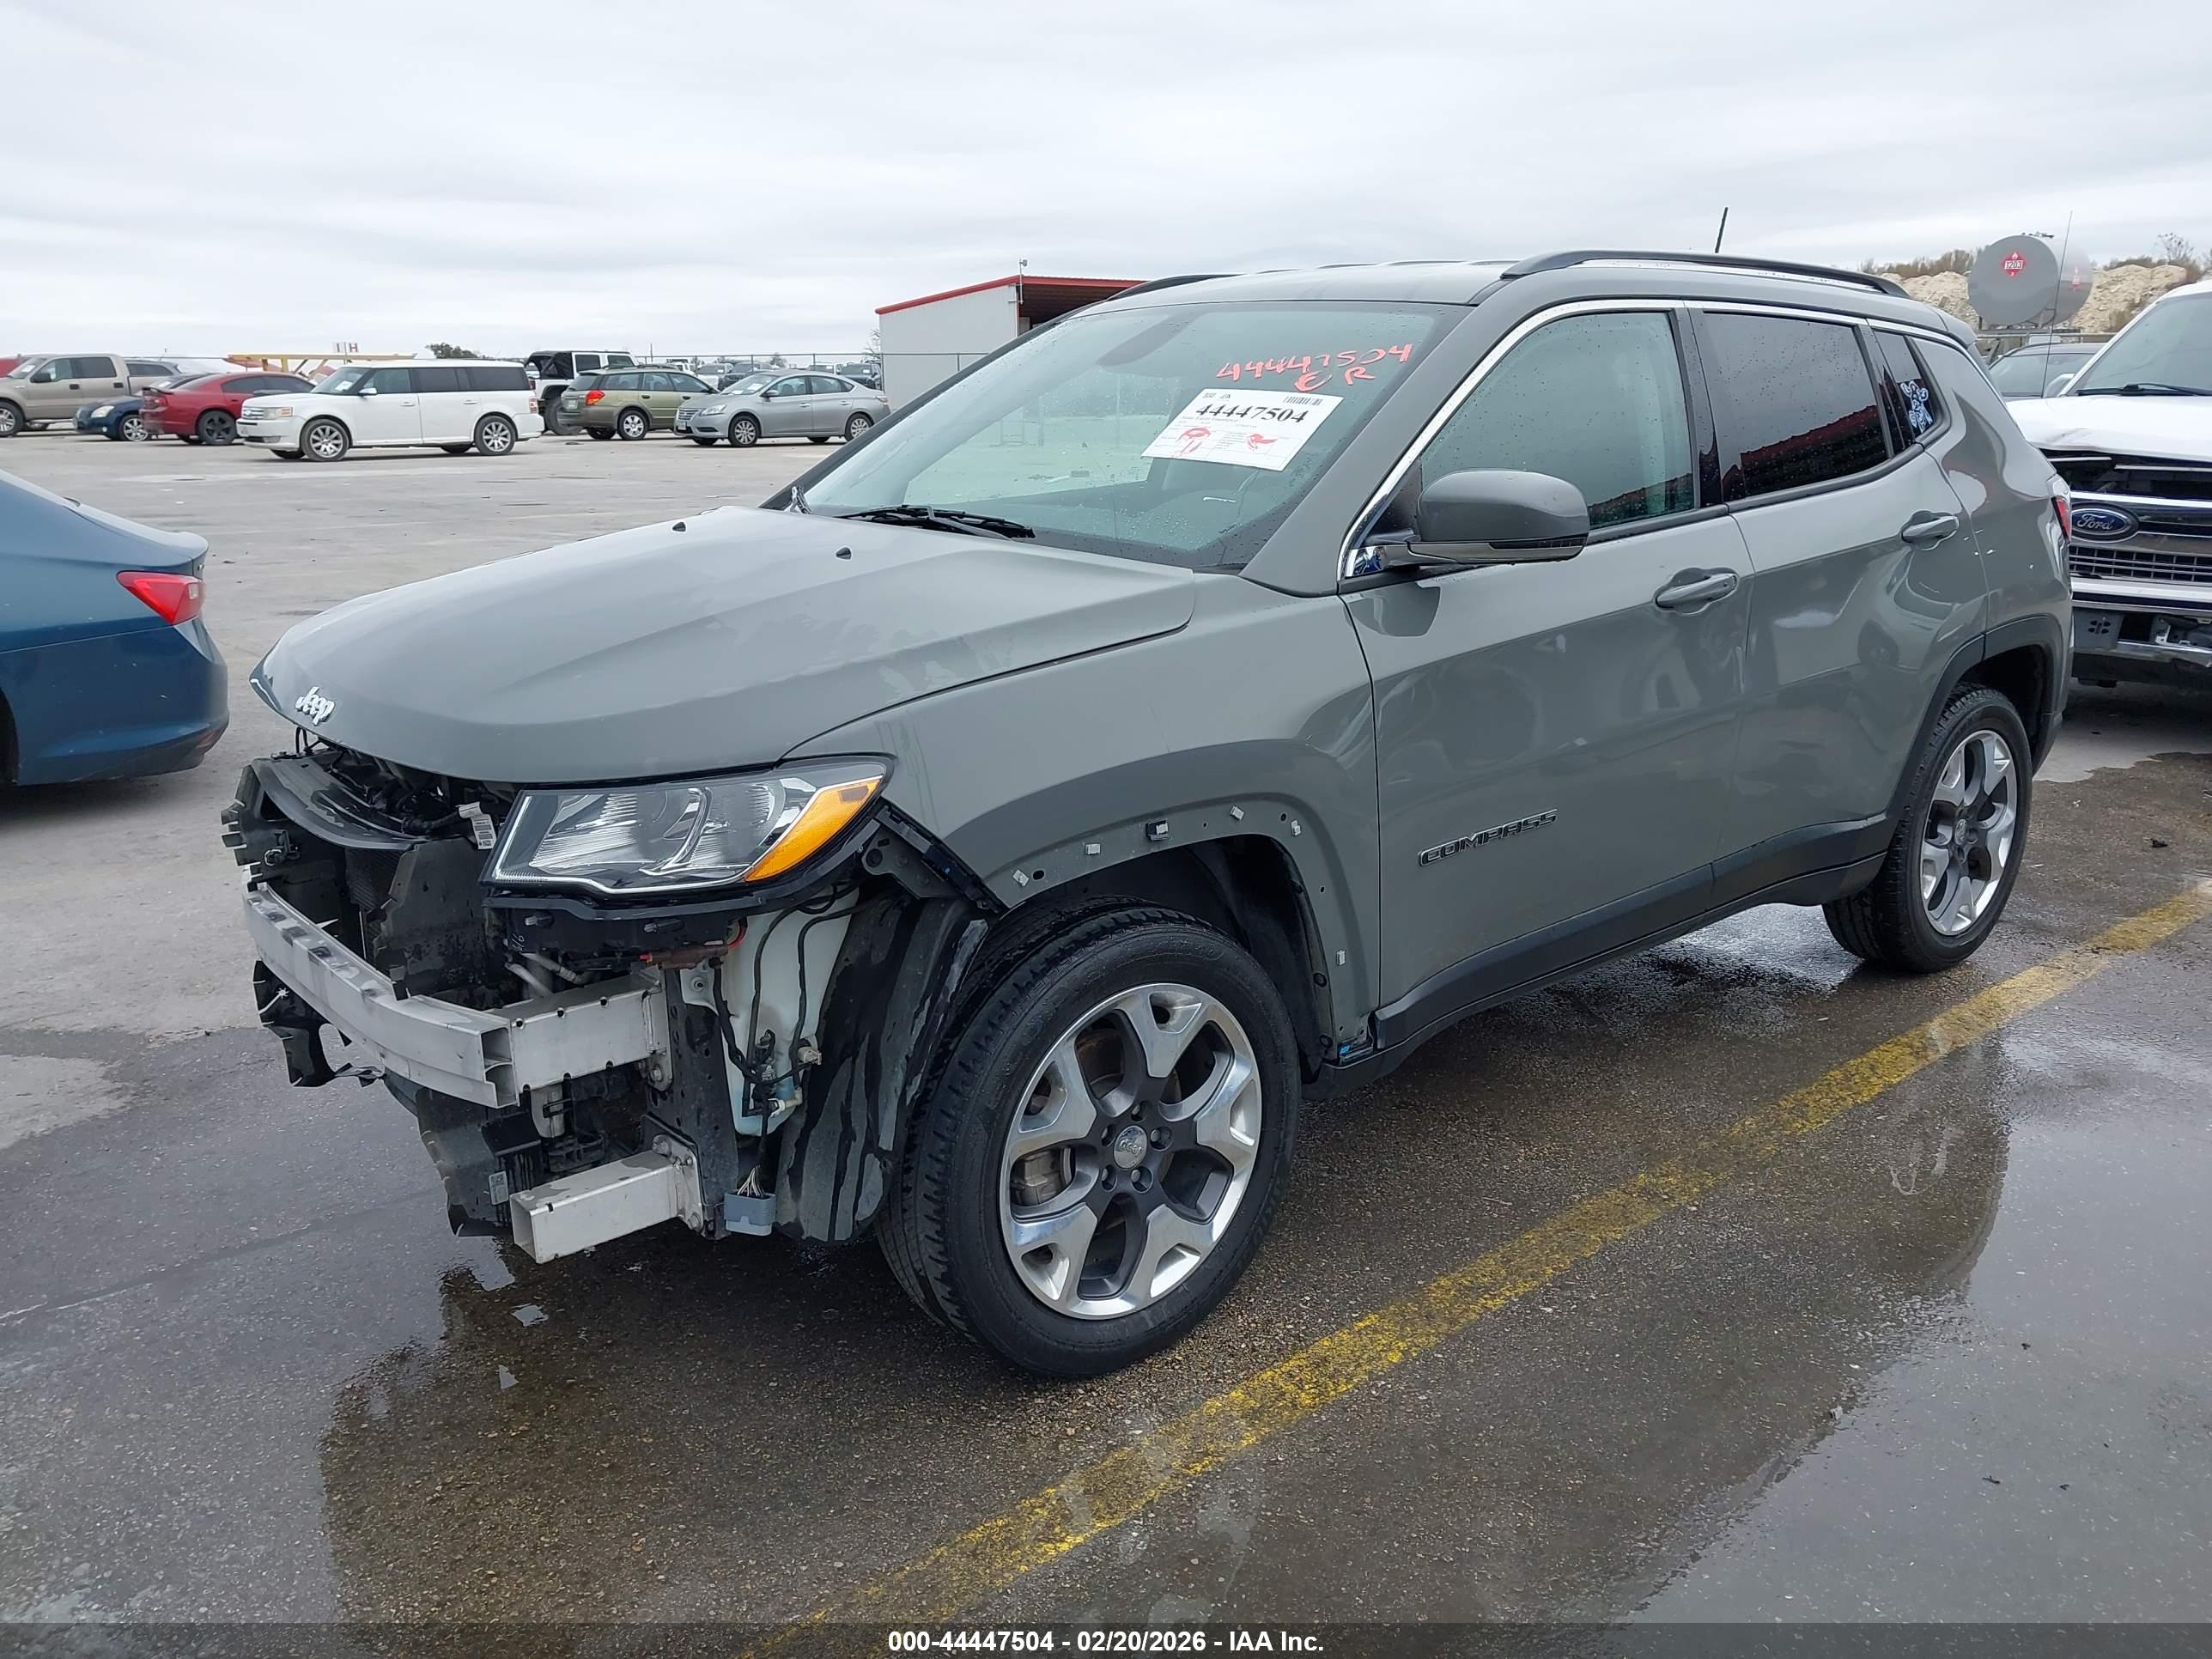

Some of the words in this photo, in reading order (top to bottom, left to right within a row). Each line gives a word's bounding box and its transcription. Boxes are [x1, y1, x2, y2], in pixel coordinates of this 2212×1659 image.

[1195, 404, 1310, 423] 44447504
[2076, 513, 2115, 530] Ford
[295, 686, 336, 726] Jeep
[1418, 808, 1559, 866] COMPASS
